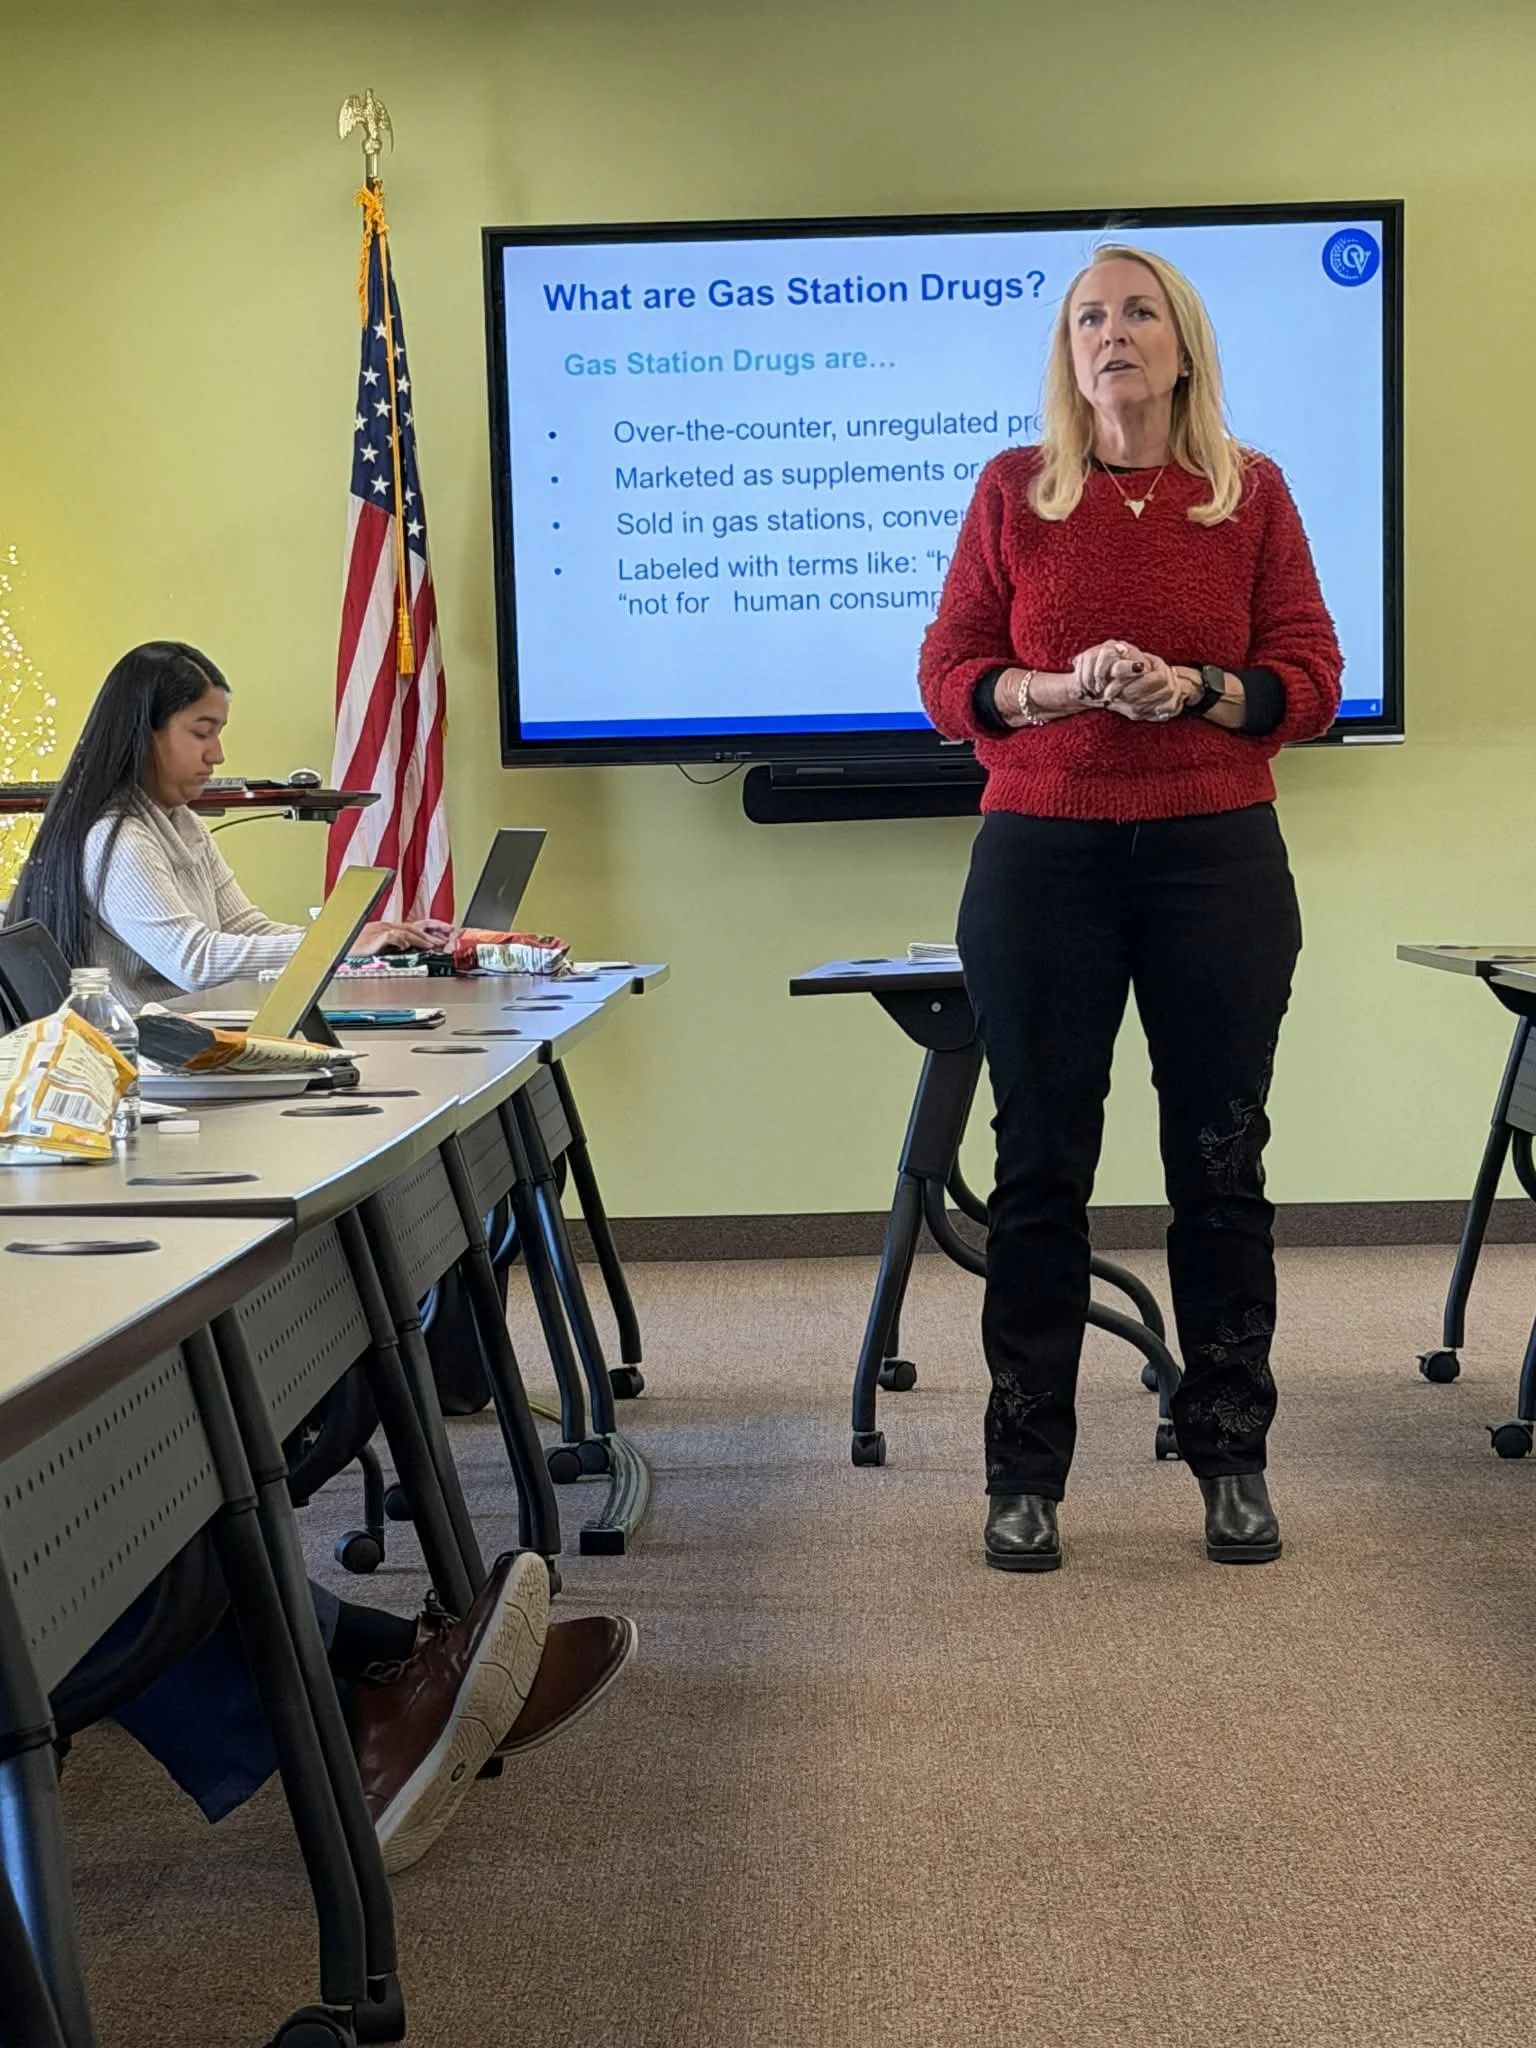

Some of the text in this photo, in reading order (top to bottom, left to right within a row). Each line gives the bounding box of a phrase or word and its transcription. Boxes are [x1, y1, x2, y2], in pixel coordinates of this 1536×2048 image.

[543, 269, 1046, 311] What are Gas Station Drugs?
[564, 353, 617, 377] Gas
[626, 349, 724, 376] Station
[733, 349, 816, 377] Drugs
[613, 415, 838, 444] Over-the-counter,
[846, 409, 998, 442] unregulated
[615, 459, 980, 491] Marketed as supplements or
[617, 511, 673, 536] Sold
[682, 511, 704, 534] in
[712, 514, 759, 539] gas
[767, 507, 873, 533] stations,
[618, 557, 719, 581] Labeled
[728, 554, 779, 578] with
[787, 554, 858, 577] terms
[867, 550, 917, 575] like:
[618, 591, 669, 616] “not
[676, 590, 711, 615] for
[733, 589, 820, 613] human
